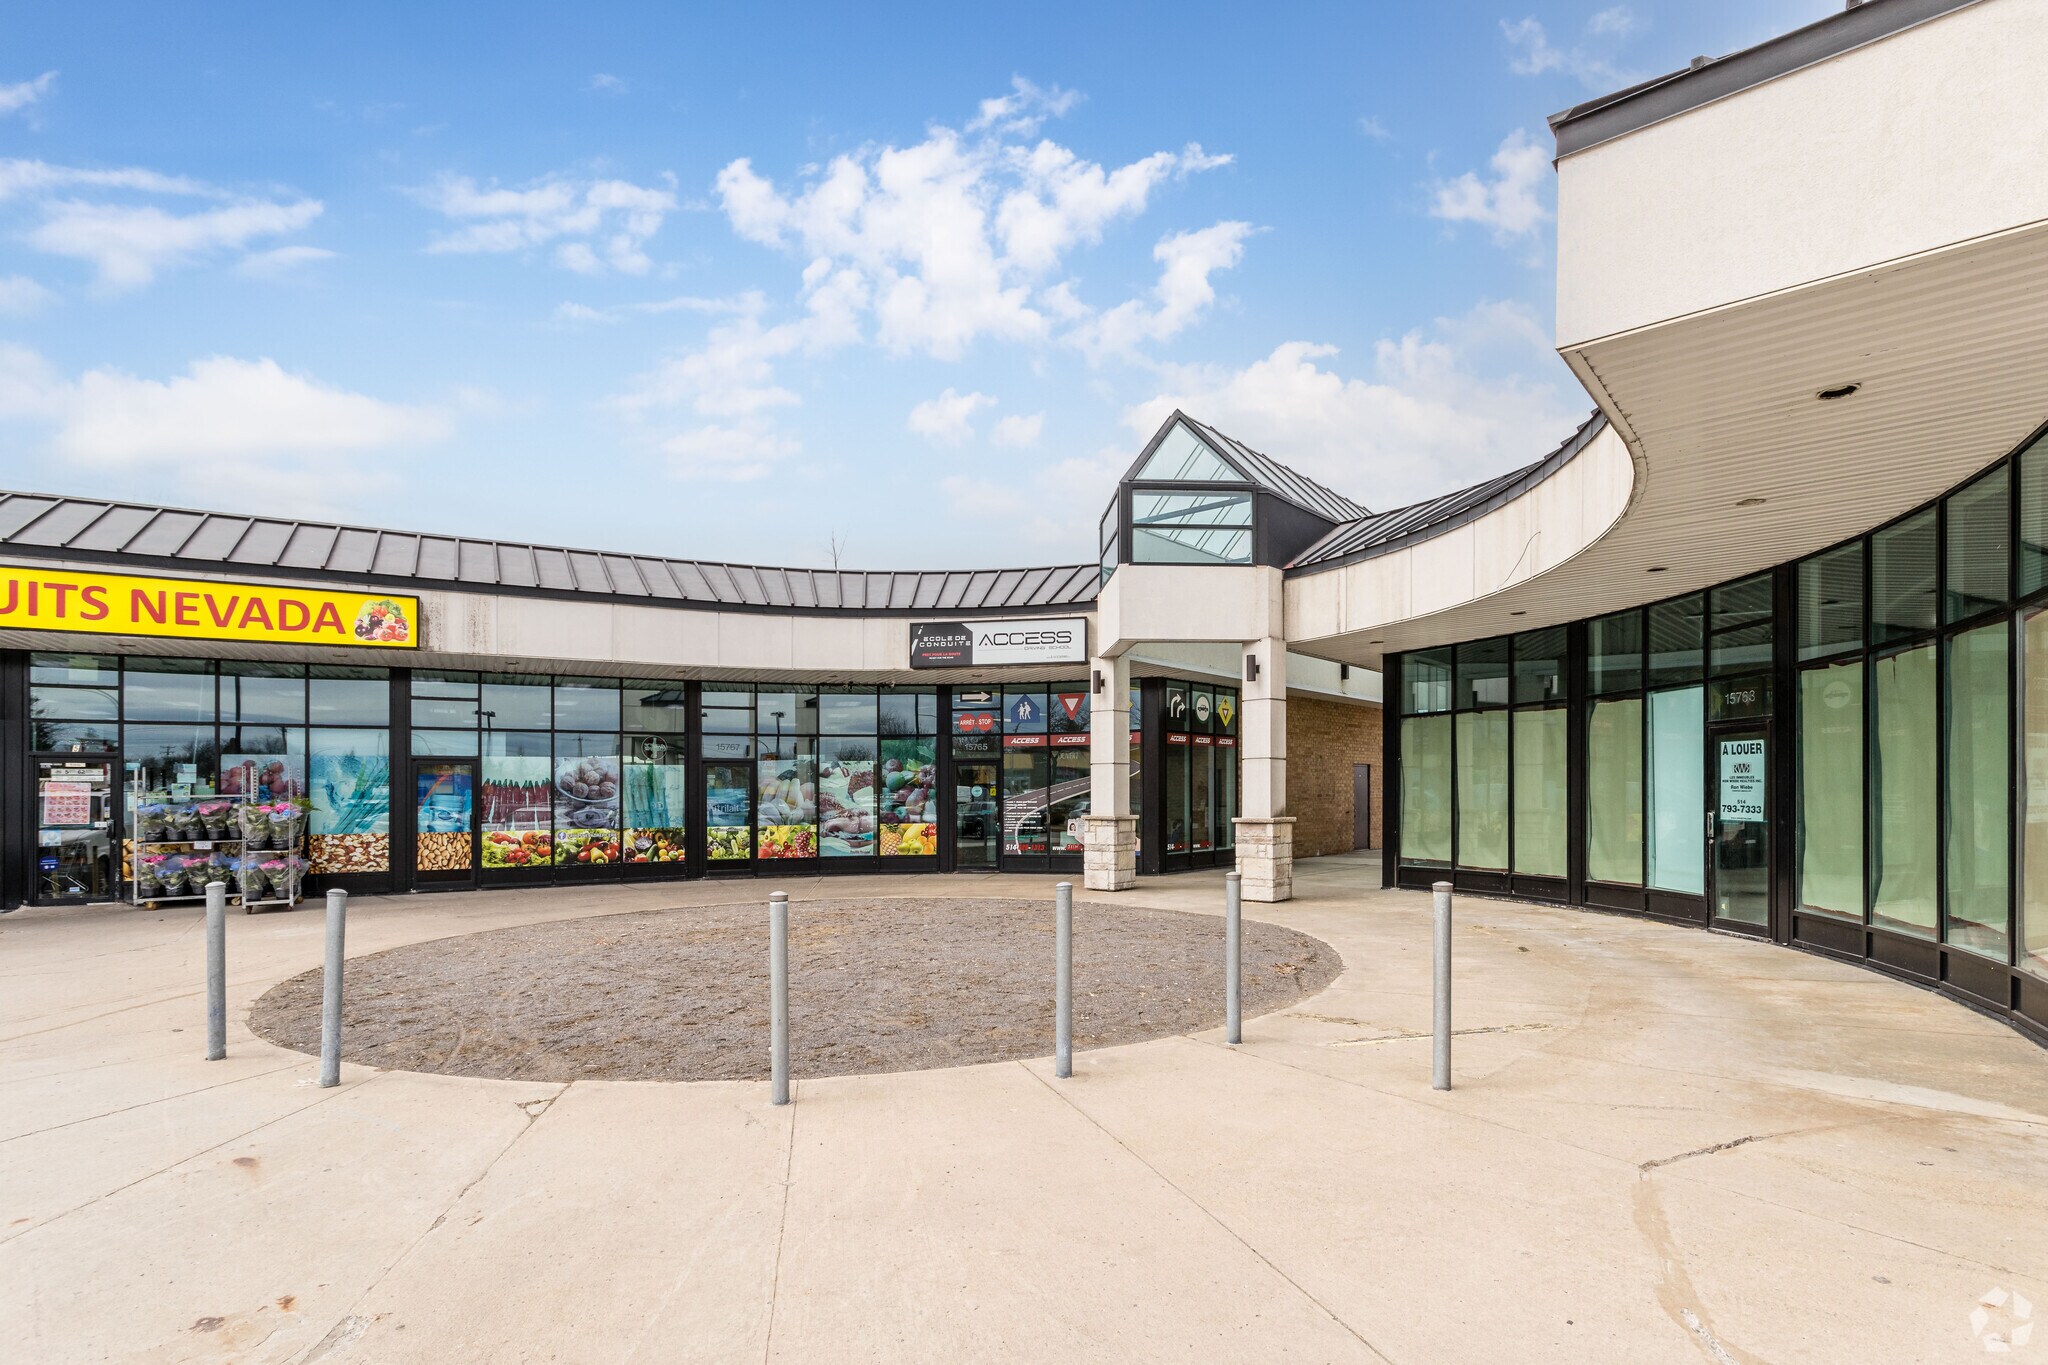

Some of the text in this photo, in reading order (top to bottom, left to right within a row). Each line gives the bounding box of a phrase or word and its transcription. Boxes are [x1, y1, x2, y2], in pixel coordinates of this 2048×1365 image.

[130, 588, 346, 634] NEVADA
[978, 630, 1072, 646] ACCESS
[959, 718, 975, 726] ARRÊT
[977, 718, 992, 726] STOP
[715, 743, 740, 751] 15767
[964, 743, 988, 751] 15765
[1722, 743, 1762, 756] À LOUER
[1722, 804, 1762, 814] 793-7333
